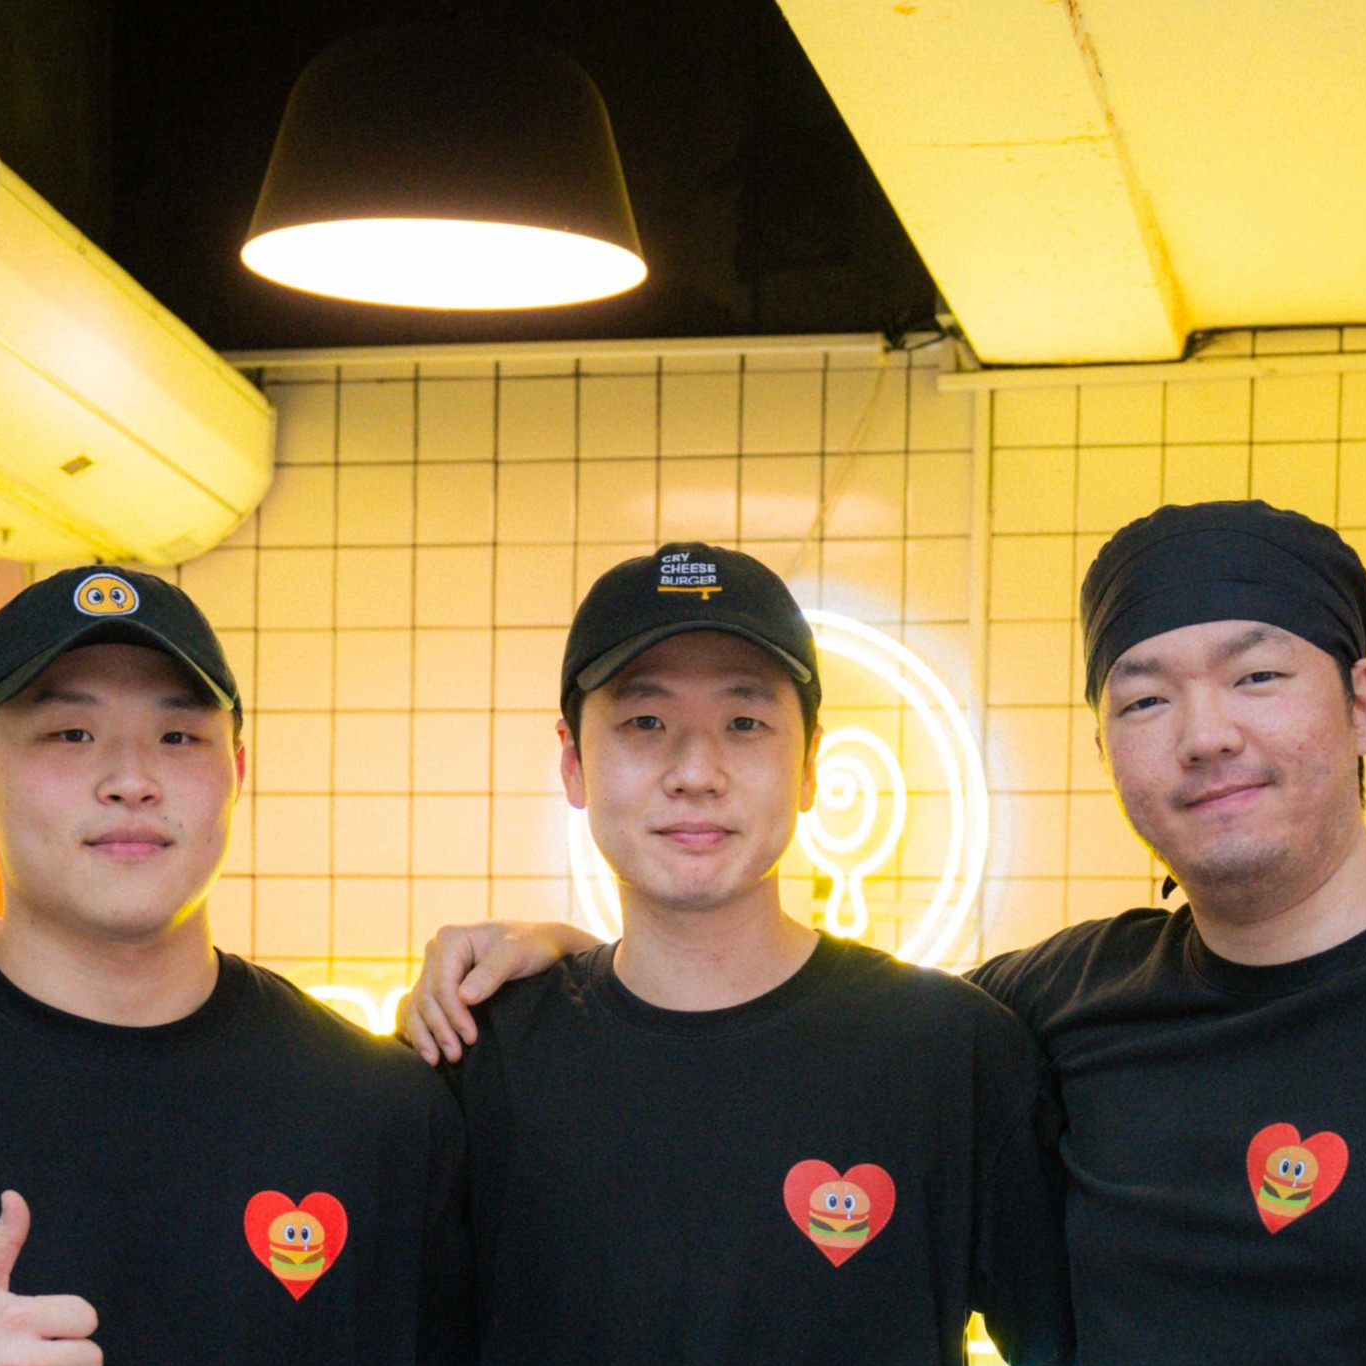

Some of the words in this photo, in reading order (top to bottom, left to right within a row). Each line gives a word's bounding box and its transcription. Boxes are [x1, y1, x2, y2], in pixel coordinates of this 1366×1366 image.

[661, 552, 691, 563] CRY
[660, 564, 717, 574] CHEESE
[660, 575, 717, 585] BURGER
